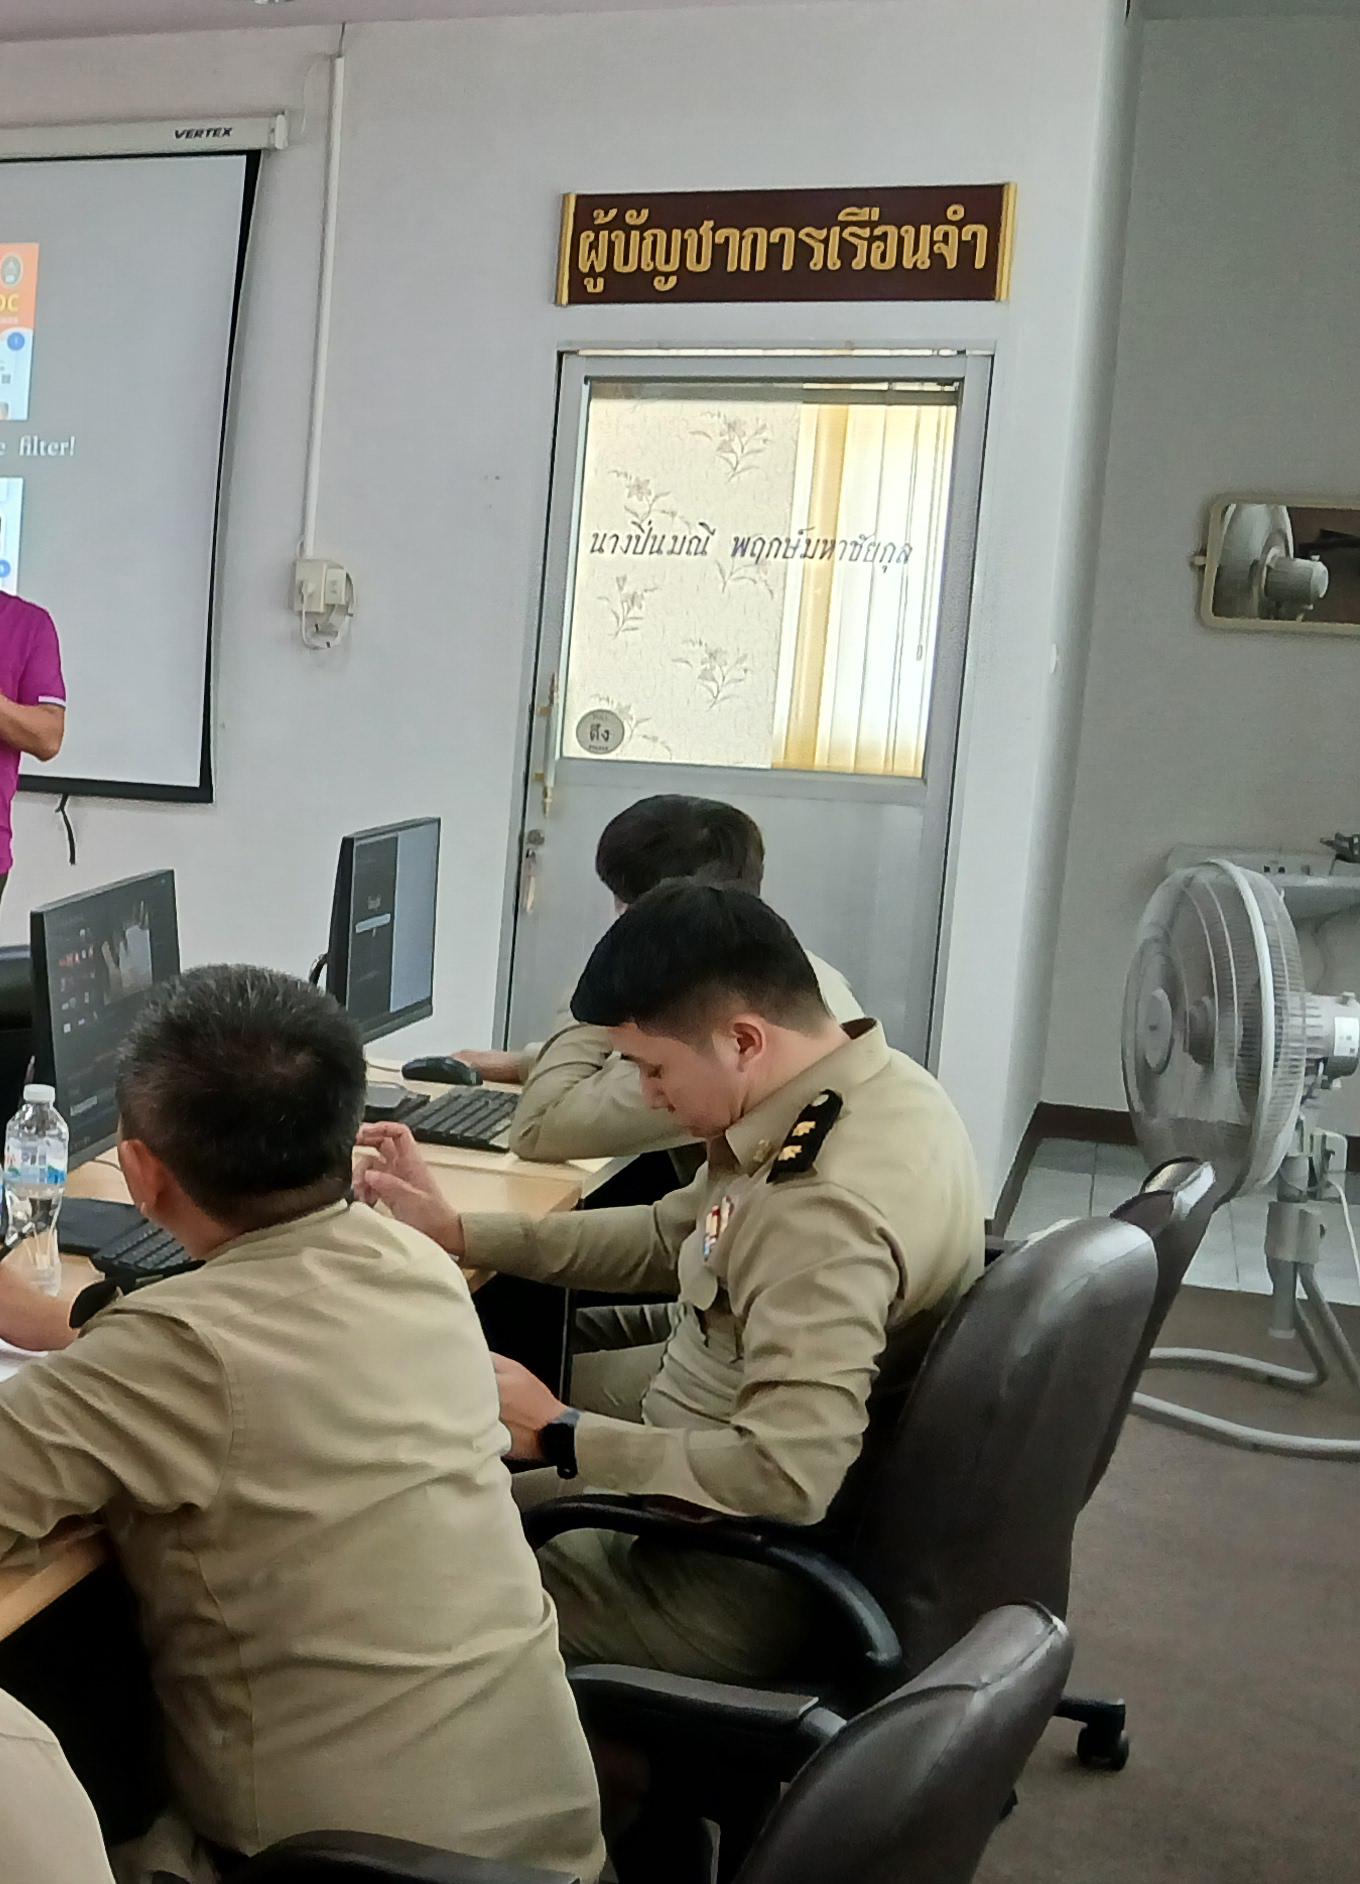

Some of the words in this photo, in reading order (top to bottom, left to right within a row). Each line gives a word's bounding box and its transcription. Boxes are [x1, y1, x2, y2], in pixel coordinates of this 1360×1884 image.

[174, 126, 233, 139] VERTEX
[578, 203, 988, 293] ผู้บัญชาการเรือนจำ
[18, 434, 76, 457] filter!
[589, 519, 717, 557] นางปิ่นมณี
